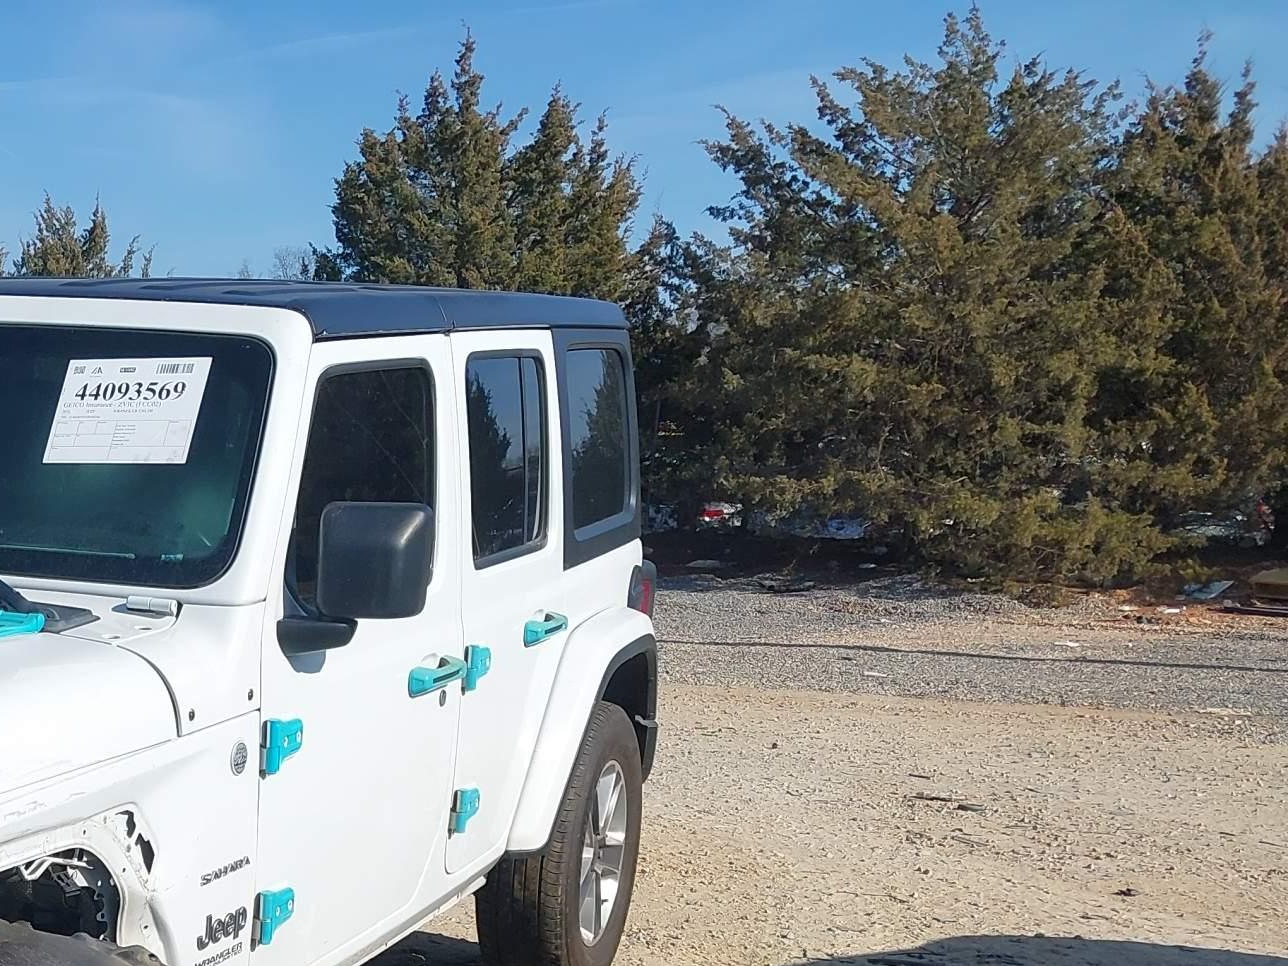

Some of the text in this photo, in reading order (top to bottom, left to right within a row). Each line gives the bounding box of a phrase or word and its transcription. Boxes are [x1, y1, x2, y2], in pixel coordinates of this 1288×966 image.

[75, 381, 187, 401] 44093569
[200, 855, 251, 887] SAHARA
[196, 906, 247, 951] Jeep
